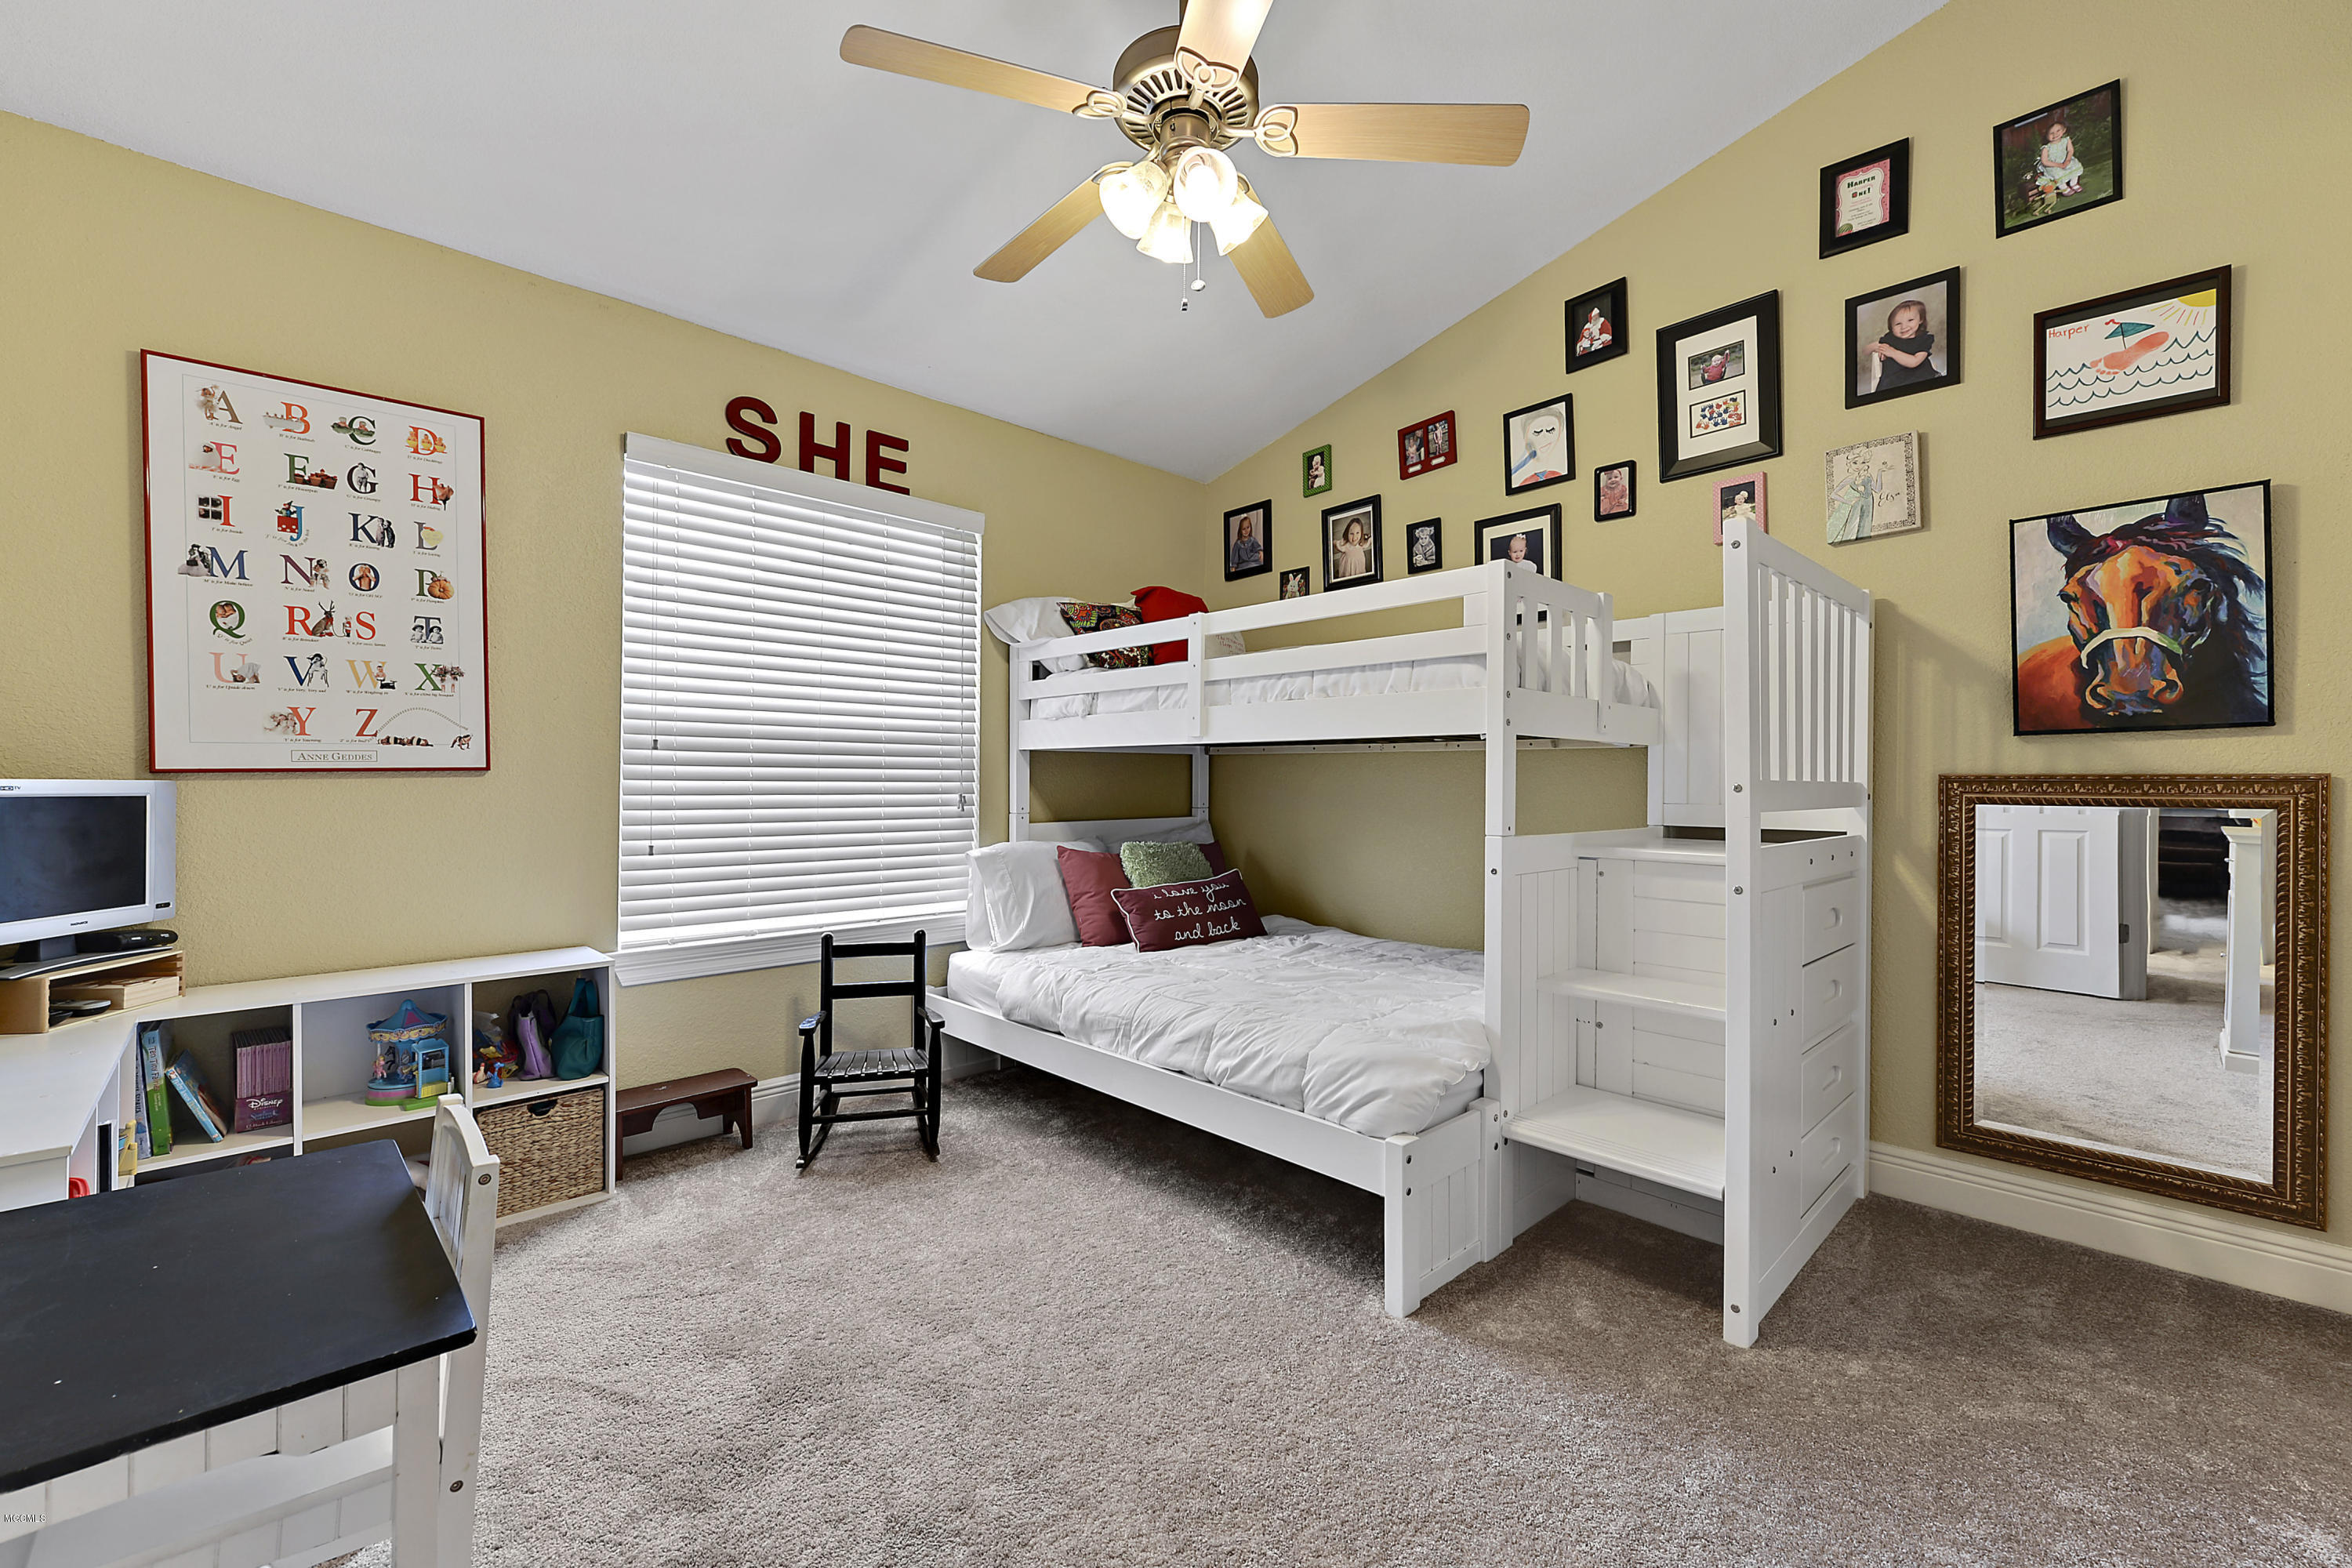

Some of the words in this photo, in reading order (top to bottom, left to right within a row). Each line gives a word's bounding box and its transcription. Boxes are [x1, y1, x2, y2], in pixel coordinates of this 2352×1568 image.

[2048, 324, 2089, 339] Harper
[212, 390, 243, 424] A
[281, 401, 310, 434] B
[347, 416, 376, 445] C
[408, 425, 437, 456] D
[725, 396, 910, 495] SHE
[210, 441, 240, 475] E
[283, 453, 310, 484] F
[347, 464, 379, 494] G
[408, 473, 442, 505] H
[217, 495, 235, 527] I
[290, 505, 305, 542] J
[347, 512, 379, 543] K
[414, 521, 437, 550] L
[205, 546, 250, 581] M
[279, 554, 316, 585] N
[349, 563, 380, 592] O
[209, 600, 246, 639] Q
[283, 604, 313, 637] R
[355, 611, 376, 640] S
[414, 615, 441, 642] T
[209, 652, 249, 683] U
[283, 655, 314, 686] V
[345, 659, 389, 689] W
[414, 662, 443, 691] X
[287, 706, 317, 736] Y
[355, 708, 379, 737] Z
[297, 752, 328, 760] ANNE
[1154, 891, 1162, 899] i
[1161, 887, 1198, 898] love
[1200, 882, 1229, 902] you
[1154, 909, 1175, 921] to
[1175, 902, 1203, 917] the
[1207, 898, 1247, 913] moon
[1174, 923, 1204, 941] and
[1207, 916, 1241, 937] back
[246, 1098, 283, 1109] Disney
